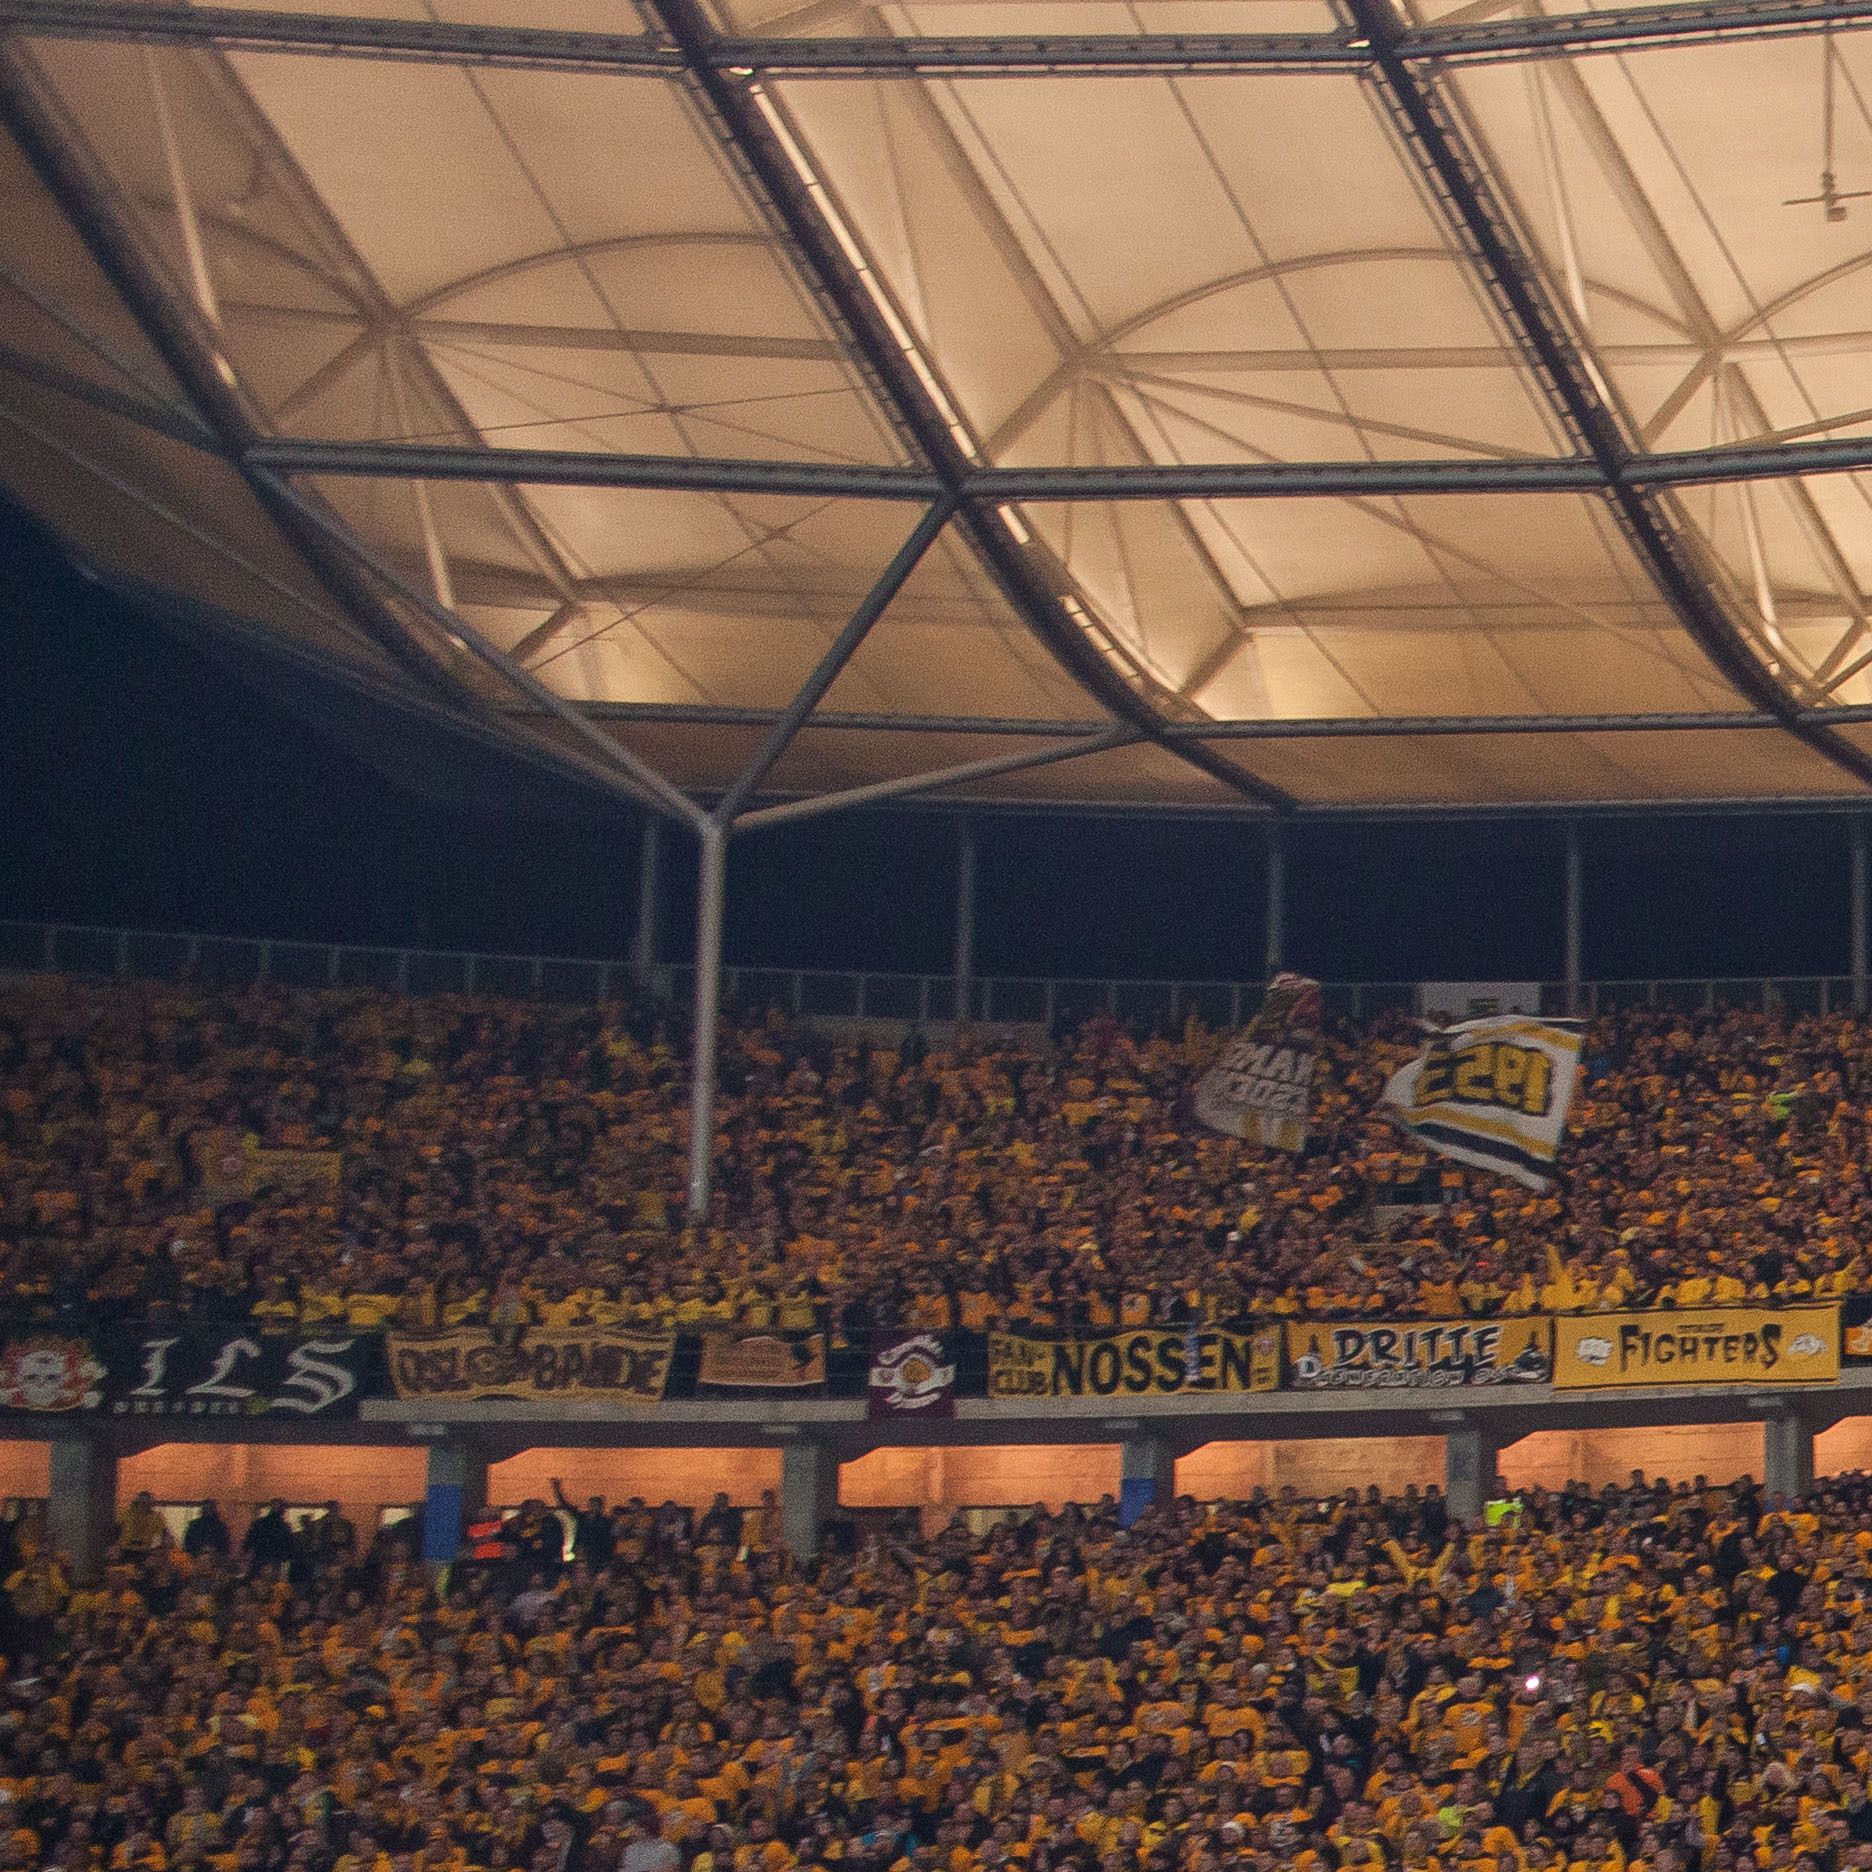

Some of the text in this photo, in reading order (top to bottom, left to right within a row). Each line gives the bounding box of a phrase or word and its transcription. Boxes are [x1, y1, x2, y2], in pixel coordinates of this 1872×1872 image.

[1051, 1335, 1252, 1395] NOSSEN
[1334, 1326, 1501, 1366] DRITTE
[1618, 1322, 1782, 1372] FIGHTERS
